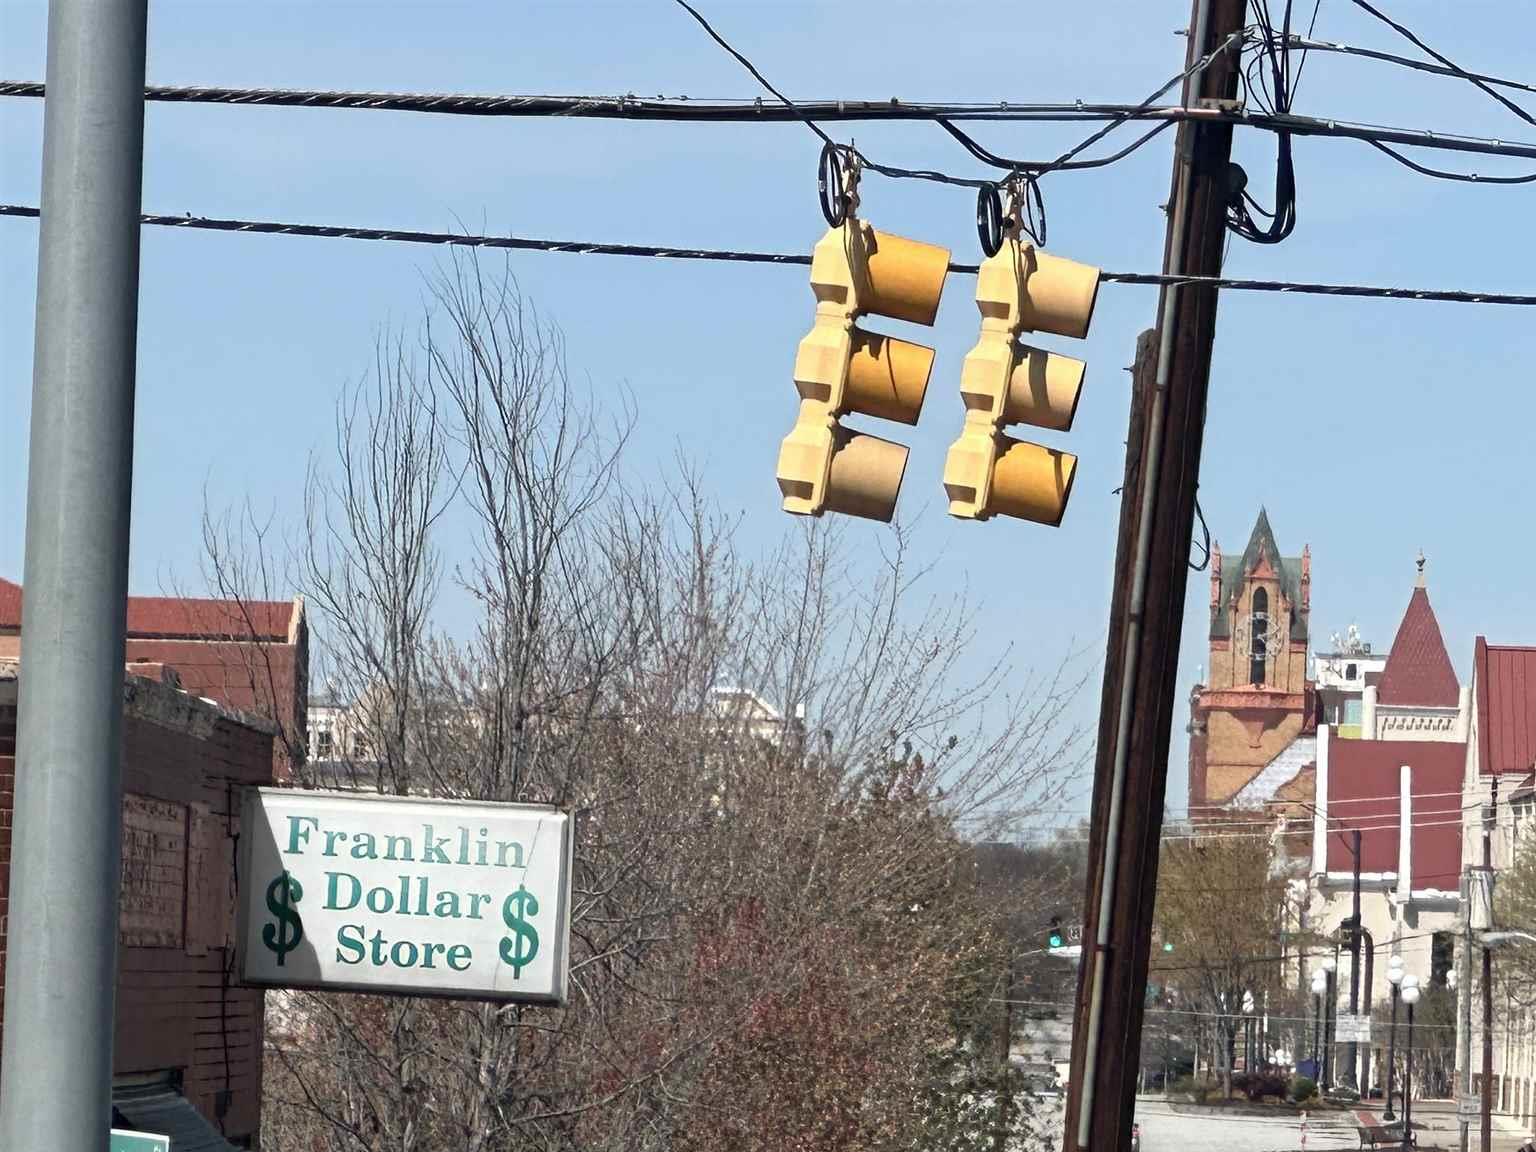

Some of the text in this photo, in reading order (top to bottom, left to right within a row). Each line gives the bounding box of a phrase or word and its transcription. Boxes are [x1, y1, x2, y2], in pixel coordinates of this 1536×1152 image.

[282, 814, 527, 869] Franklin
[321, 871, 492, 920] Dollar
[335, 923, 473, 971] Store
